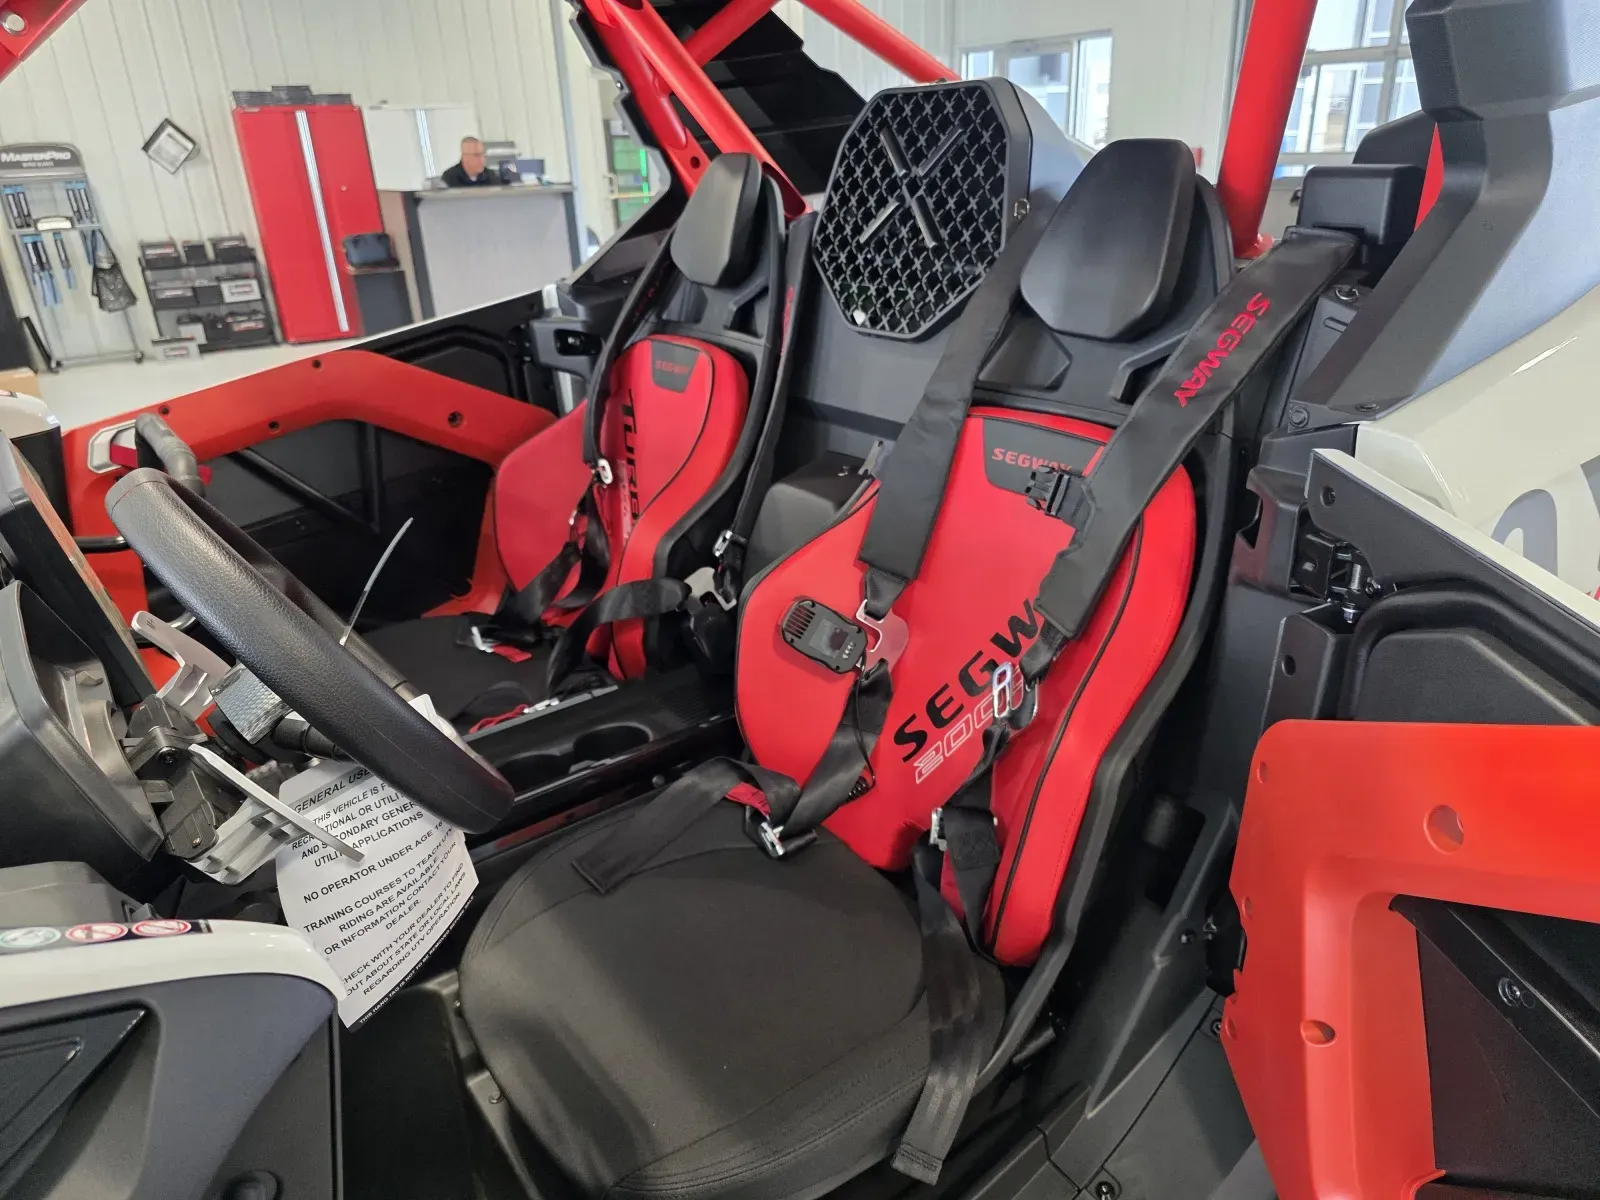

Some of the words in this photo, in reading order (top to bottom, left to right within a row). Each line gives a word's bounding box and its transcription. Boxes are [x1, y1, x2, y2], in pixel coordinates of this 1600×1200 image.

[1174, 292, 1271, 408] SEGWAY
[621, 388, 640, 521] TURB
[893, 598, 1039, 763] SEGW
[294, 781, 346, 813] GENERAL
[313, 811, 331, 825] THIS
[333, 791, 369, 815] VEHICLE
[370, 786, 379, 796] IS
[358, 804, 373, 816] OR
[374, 792, 401, 809] UTILI
[301, 844, 320, 860] AND
[382, 801, 417, 821] GENER
[352, 811, 424, 850] APPLICATIONS
[303, 891, 319, 904] NO
[320, 864, 377, 895] OPERATOR
[377, 844, 413, 868] UNDER
[415, 830, 433, 847] AGE
[434, 821, 443, 831] 16
[303, 905, 354, 933] TRAINING
[354, 877, 402, 909] COURSES
[402, 867, 416, 879] TO
[416, 842, 442, 868] TEACH
[324, 942, 341, 955] OR
[340, 900, 406, 946] INFORMATION
[406, 864, 441, 901] CONTACT
[440, 841, 456, 864] YOUR
[339, 909, 374, 932] RIDING
[375, 895, 396, 912] ARE
[344, 961, 371, 984] HECK
[370, 943, 393, 963] WITH
[393, 922, 416, 944] YOUR
[416, 892, 443, 924] DEALER
[442, 881, 452, 893] TO
[451, 862, 464, 882] FIND
[365, 954, 394, 982] ABOUT
[394, 931, 419, 956] STATE
[418, 920, 430, 932] OR
[429, 895, 451, 921] LOCAL
[450, 871, 466, 896] LAWS
[385, 899, 422, 930] DEALER.
[362, 951, 411, 996] REGARDING
[411, 935, 425, 951] UTV
[359, 1011, 373, 1024] THIS
[372, 996, 389, 1012] HANG
[388, 986, 400, 998] TAG
[405, 969, 416, 982] NOT
